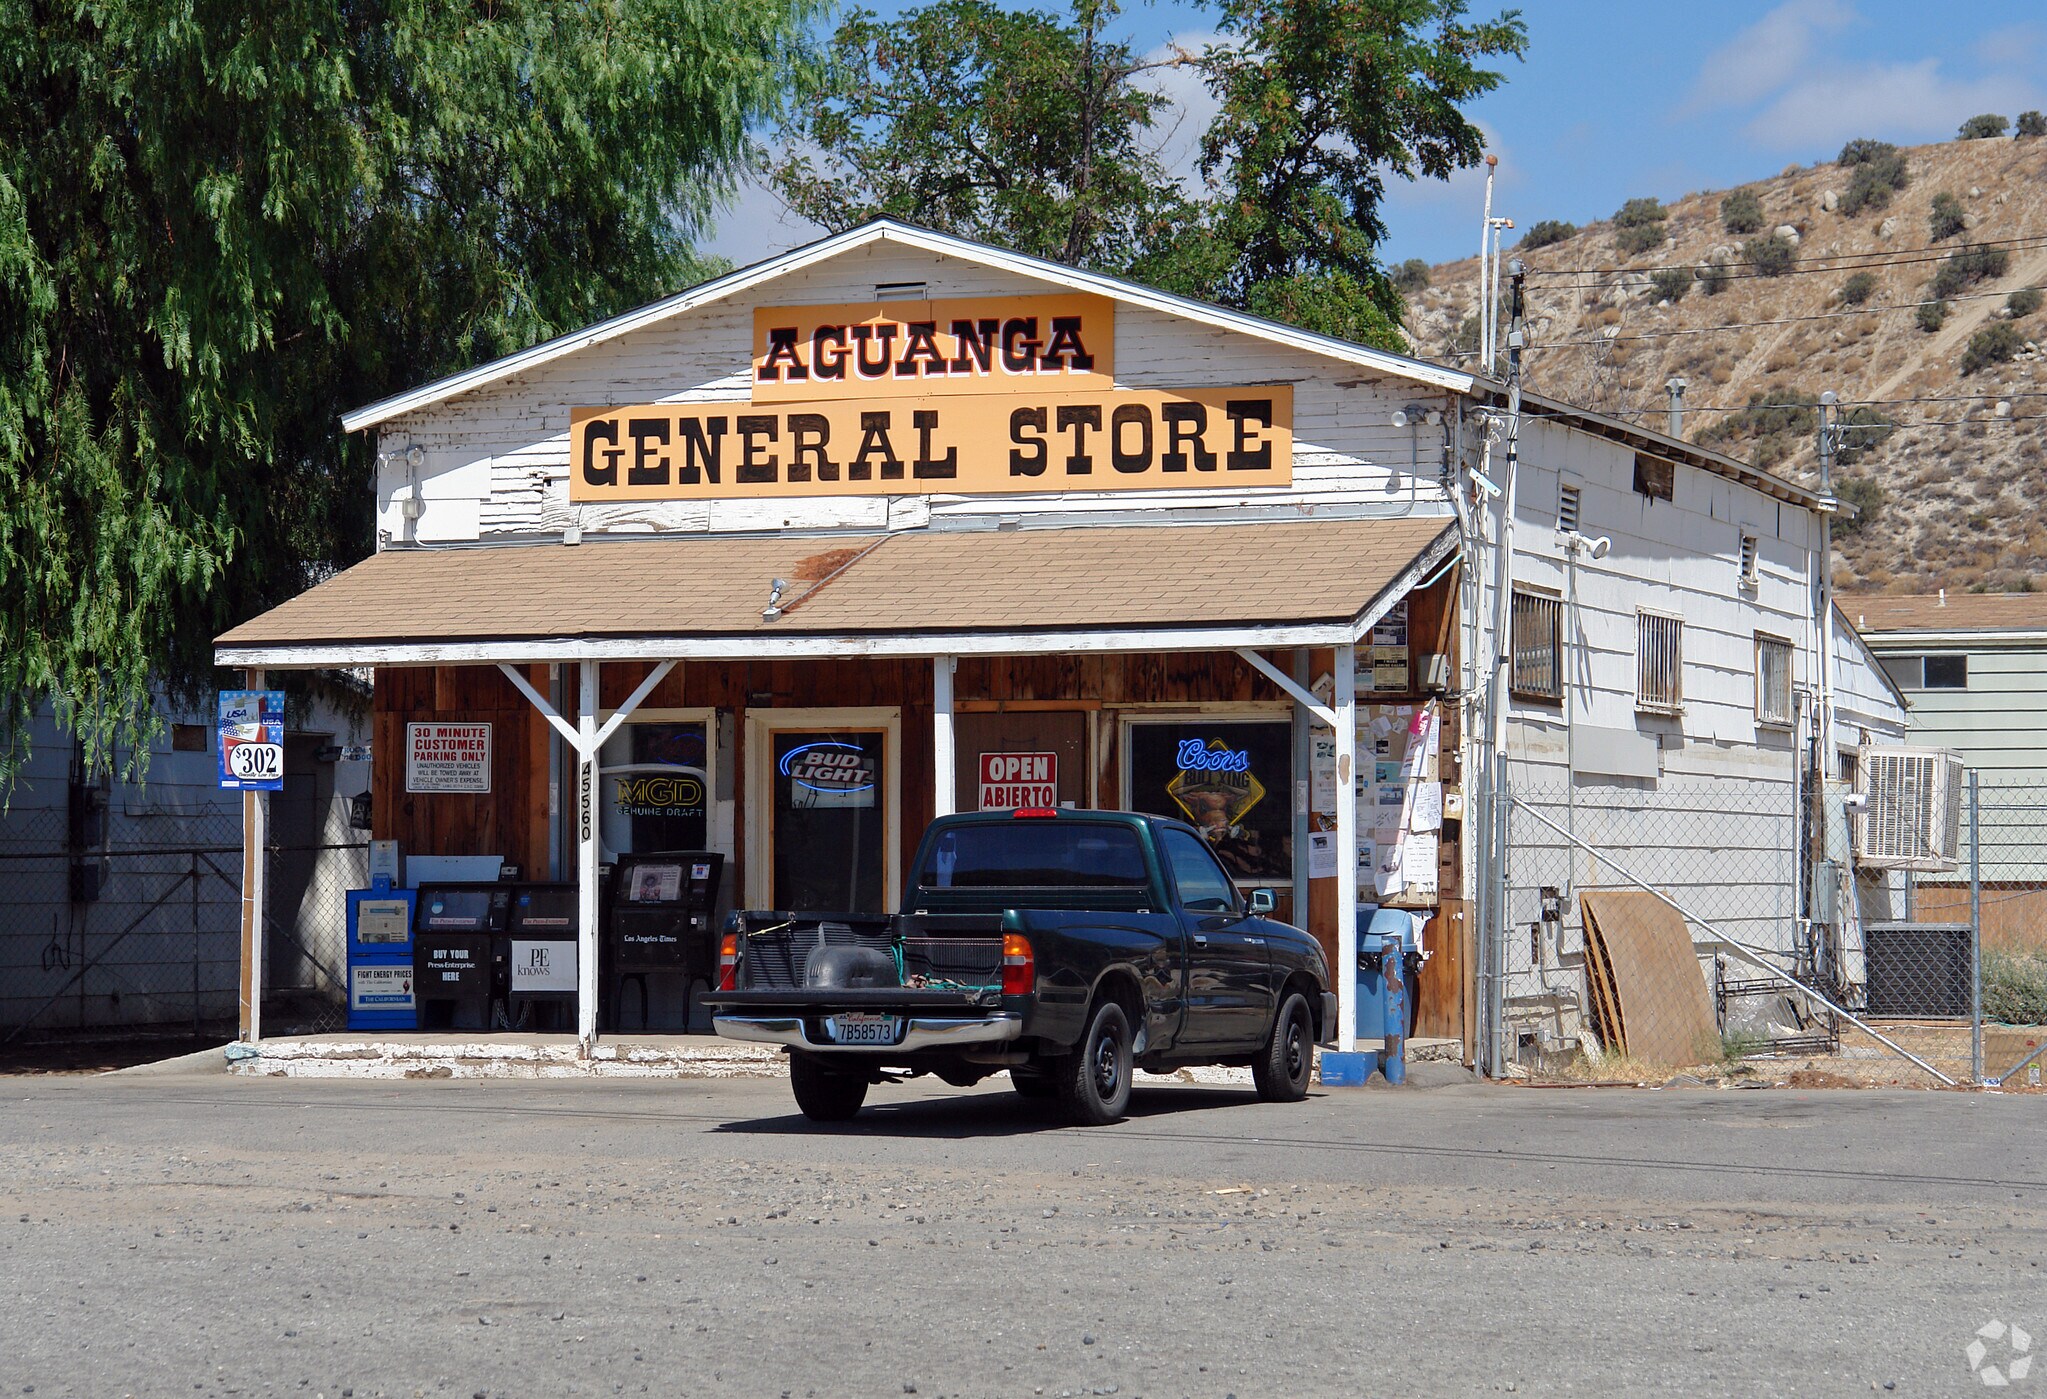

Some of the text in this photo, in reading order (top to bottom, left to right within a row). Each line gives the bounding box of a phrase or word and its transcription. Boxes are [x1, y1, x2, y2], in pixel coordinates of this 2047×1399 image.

[755, 316, 1095, 384] AGUANGA
[583, 399, 1272, 486] GENERAL STORE
[227, 709, 247, 718] USA
[414, 728, 486, 738] 30 MINUTE
[415, 739, 485, 750] CUSTOMER
[414, 751, 486, 761] PARKING ONLY
[804, 752, 861, 768] BUD
[1177, 739, 1248, 772] Coors
[791, 765, 869, 783] LIGHT
[989, 757, 1048, 781] OPEN
[614, 778, 701, 806] MGD
[983, 786, 1053, 807] ABIERTO
[582, 762, 591, 840] 45560
[616, 807, 703, 816] GENUINE DRAFT
[636, 935, 658, 943] Angeles
[433, 950, 469, 959] BUY YOUR
[358, 970, 412, 978] FIGHT ENERGY PRICES
[517, 964, 550, 976] knows
[442, 972, 460, 981] HERE
[848, 1014, 883, 1023] California
[840, 1024, 890, 1040] 7B58573
